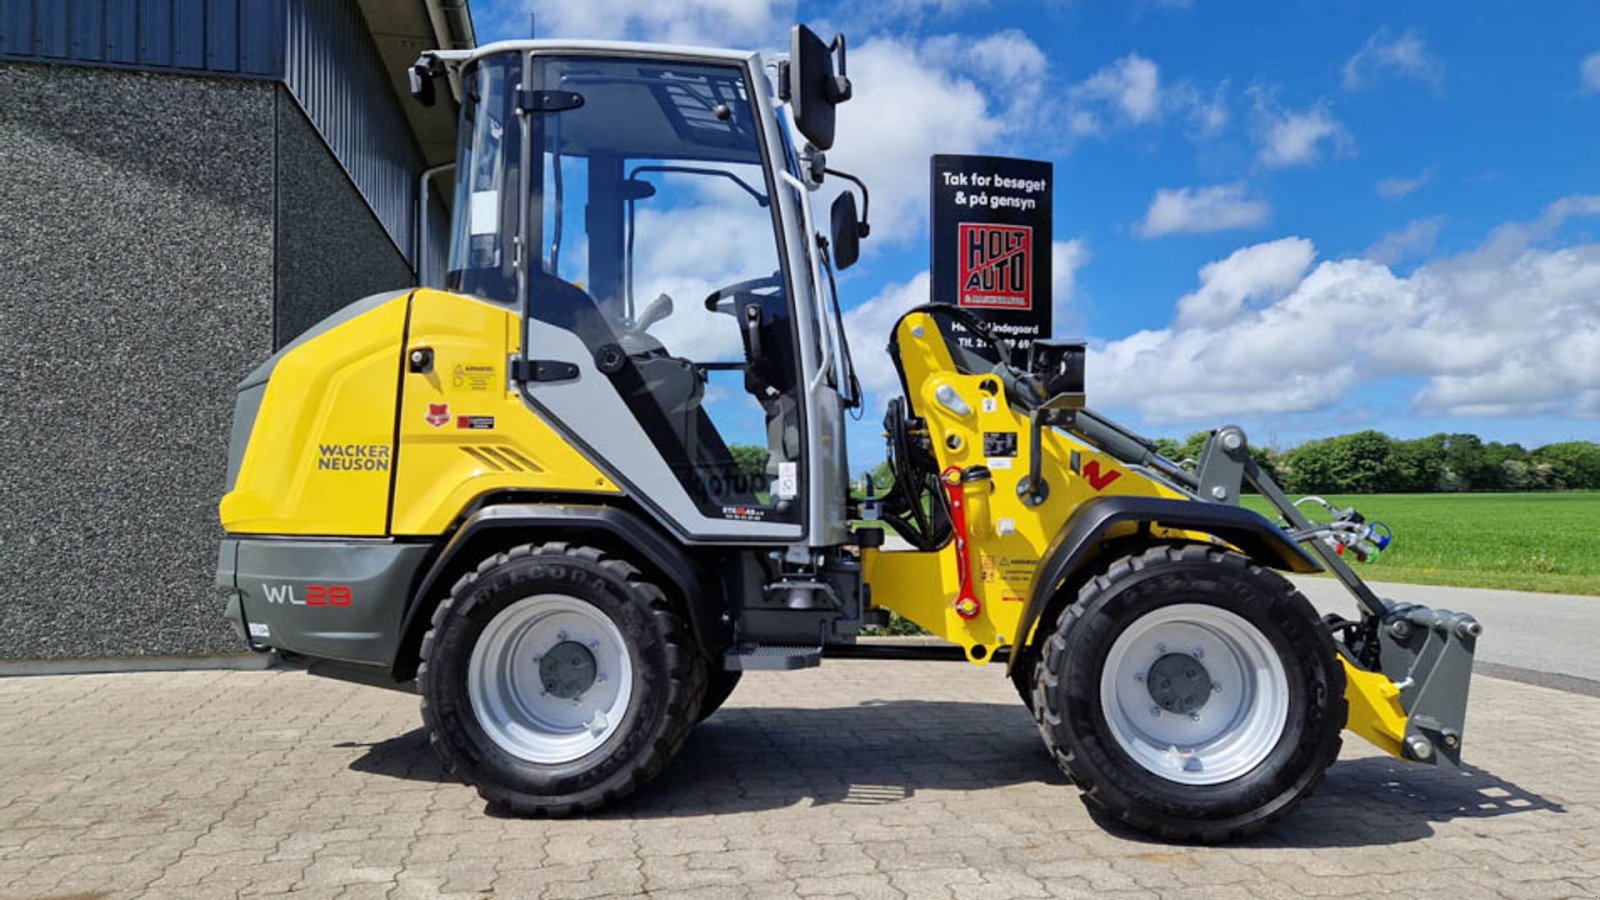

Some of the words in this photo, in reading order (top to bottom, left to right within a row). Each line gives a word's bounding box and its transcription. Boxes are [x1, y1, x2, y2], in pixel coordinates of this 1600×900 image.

[943, 172, 968, 186] Tak
[971, 173, 992, 187] for
[994, 174, 1046, 193] besøget
[954, 191, 967, 205] &
[969, 192, 988, 208] på
[990, 195, 1036, 210] gensyn
[968, 228, 1025, 270] HOLT
[965, 251, 1026, 293] AUTO
[317, 444, 390, 458] WACKER
[317, 457, 389, 471] NEUSON
[262, 583, 353, 608] WL28
